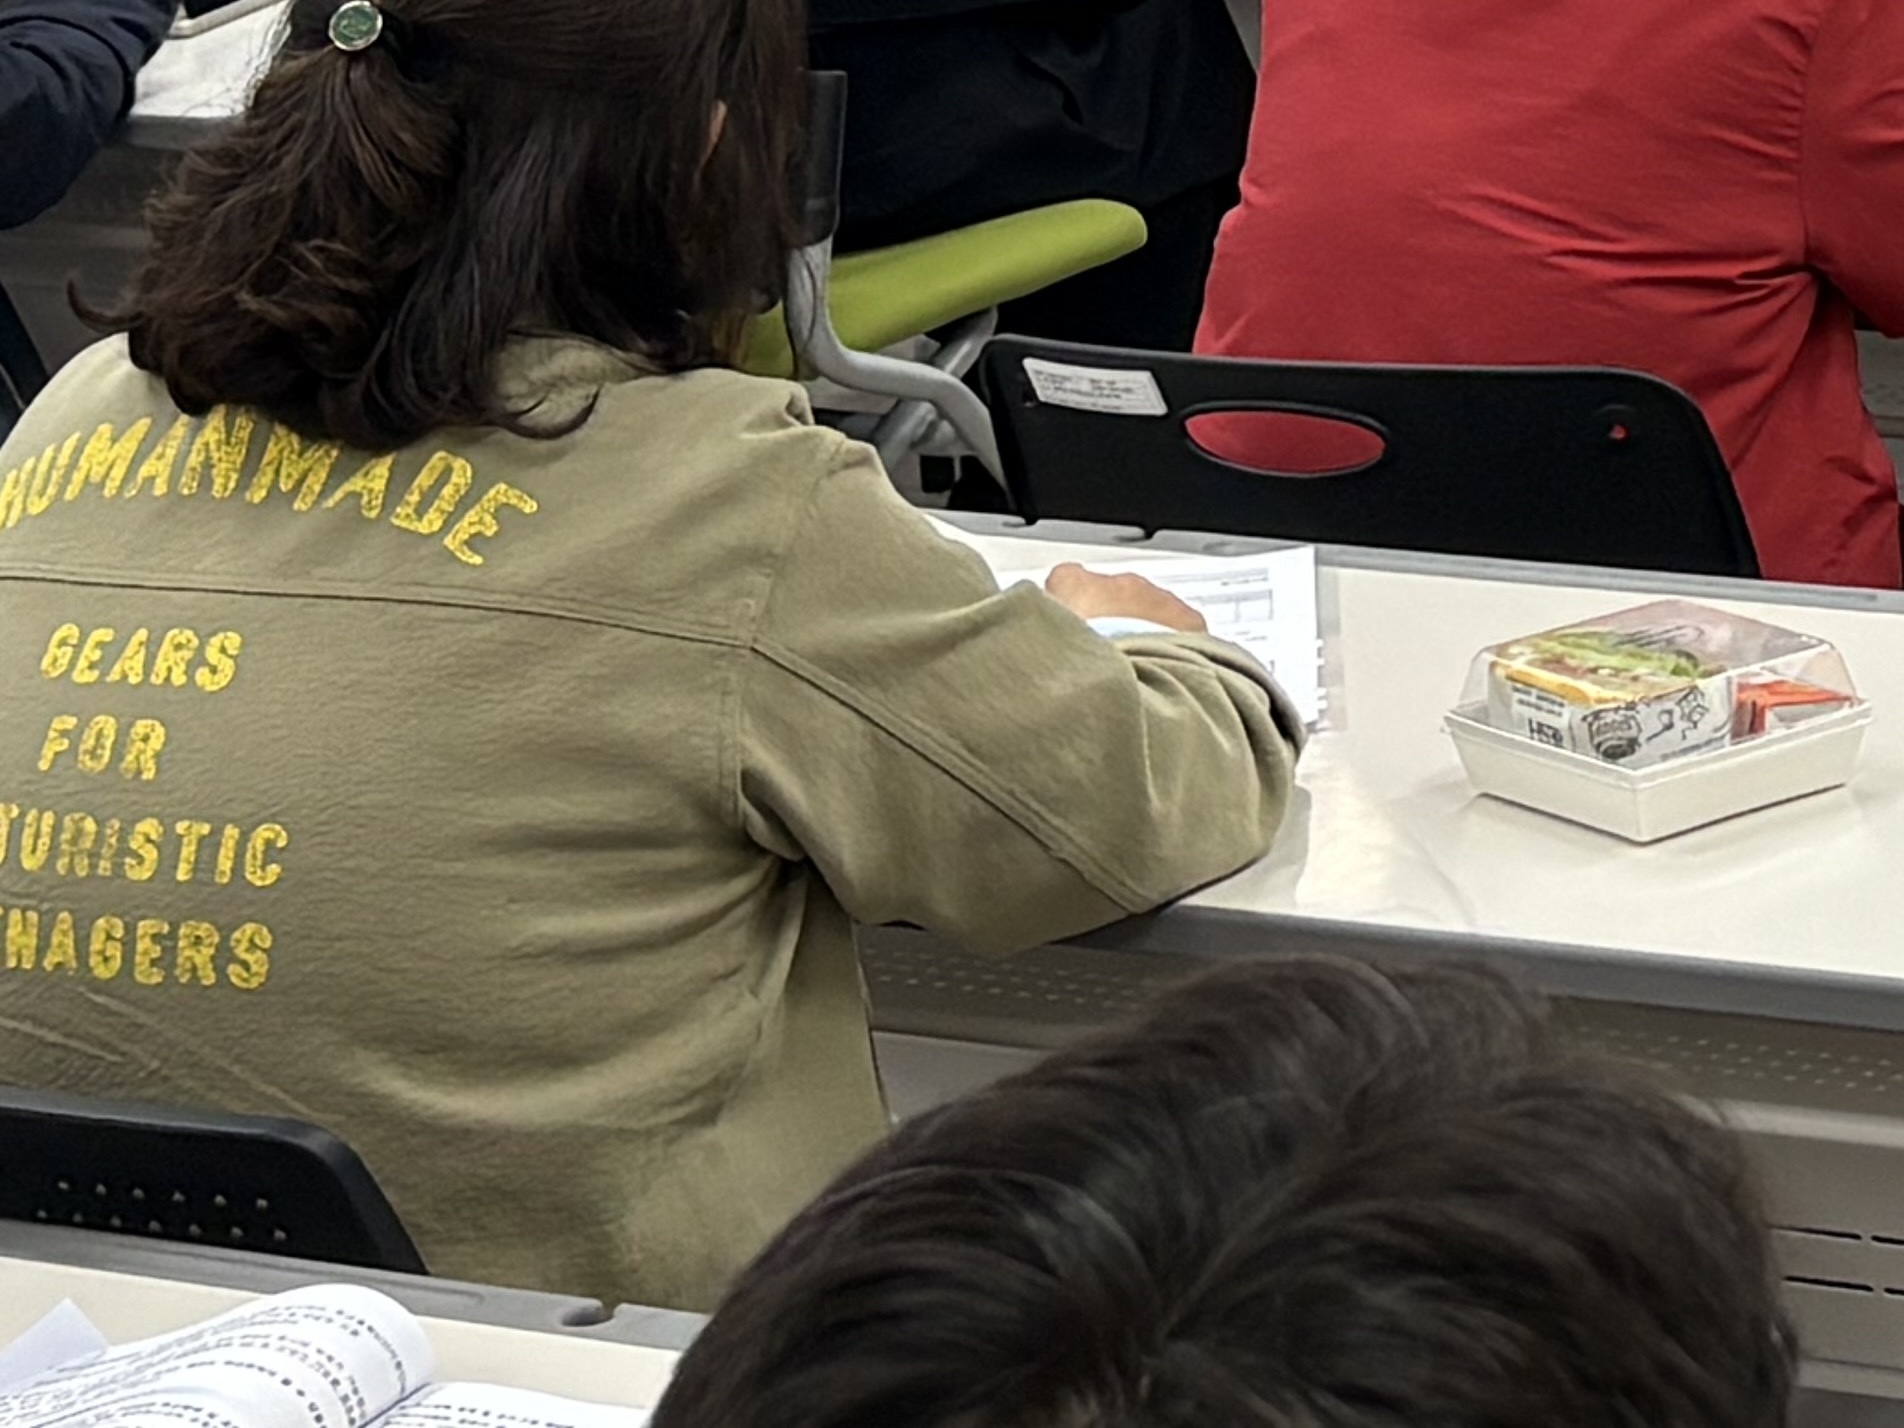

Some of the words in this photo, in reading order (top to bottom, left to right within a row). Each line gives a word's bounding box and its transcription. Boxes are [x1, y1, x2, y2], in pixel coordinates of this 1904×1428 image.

[40, 623, 242, 691] GEARS
[37, 715, 168, 781] FOR
[0, 904, 273, 989] NAGERS
